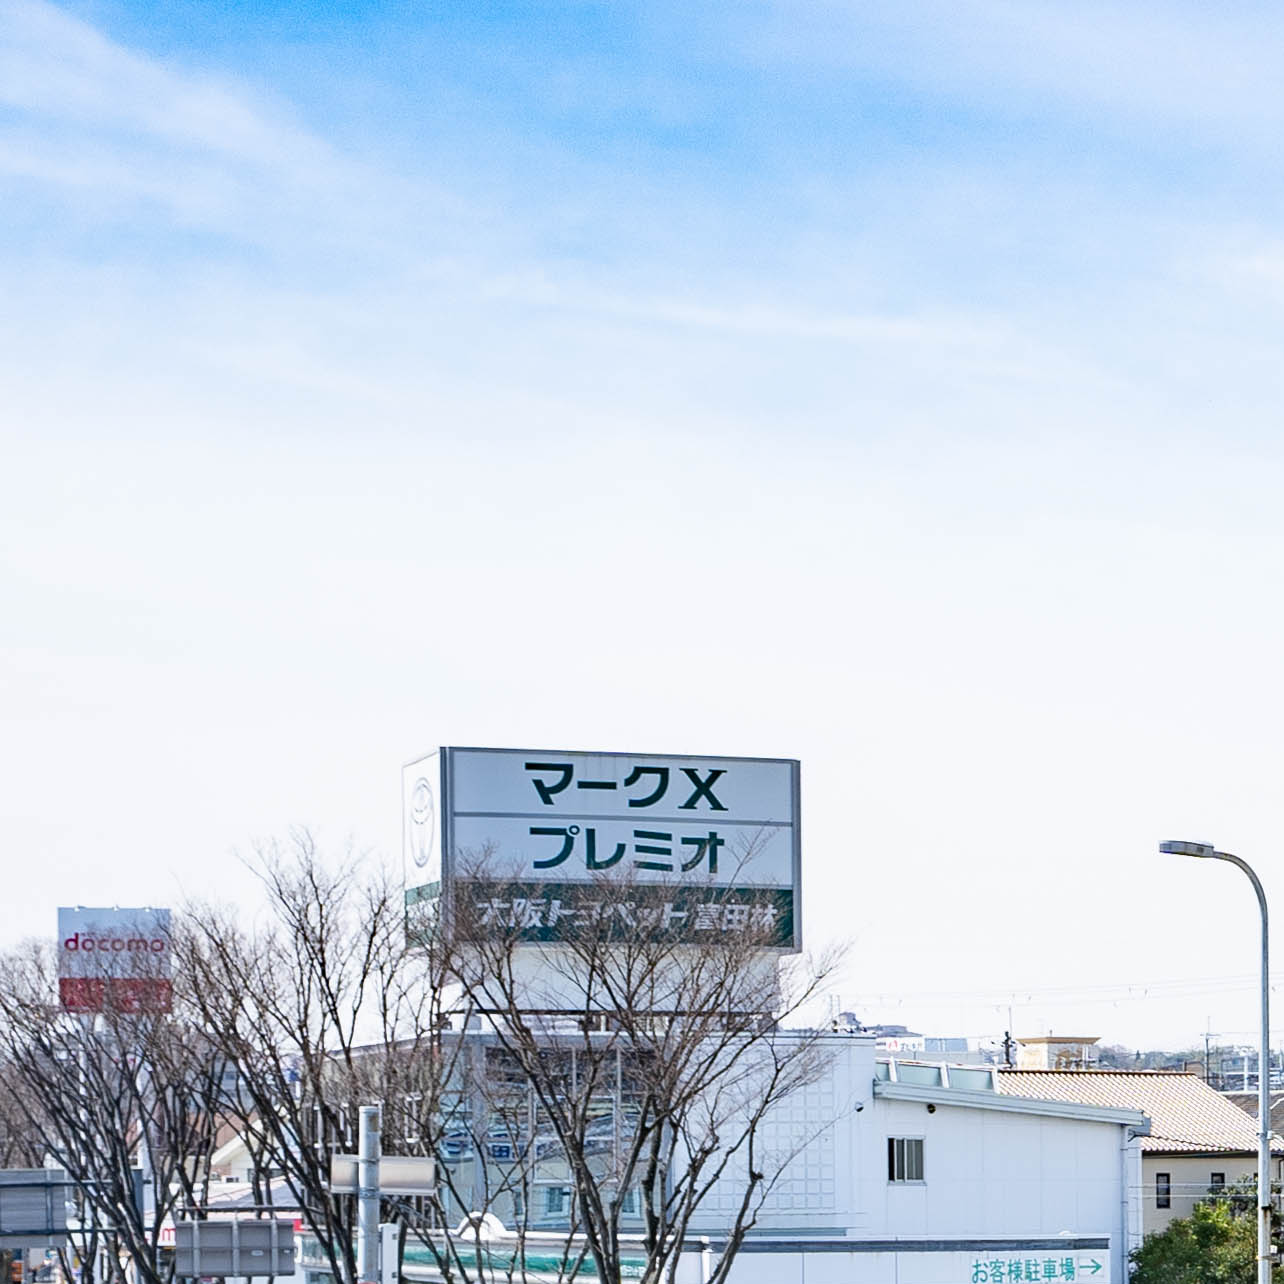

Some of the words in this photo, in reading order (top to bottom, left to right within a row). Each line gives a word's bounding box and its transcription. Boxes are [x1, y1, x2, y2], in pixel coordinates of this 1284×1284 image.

[524, 762, 729, 811] マークX
[529, 824, 725, 874] プレミオ
[64, 932, 164, 952] docomo
[971, 1257, 1076, 1284] お客様駐車場
